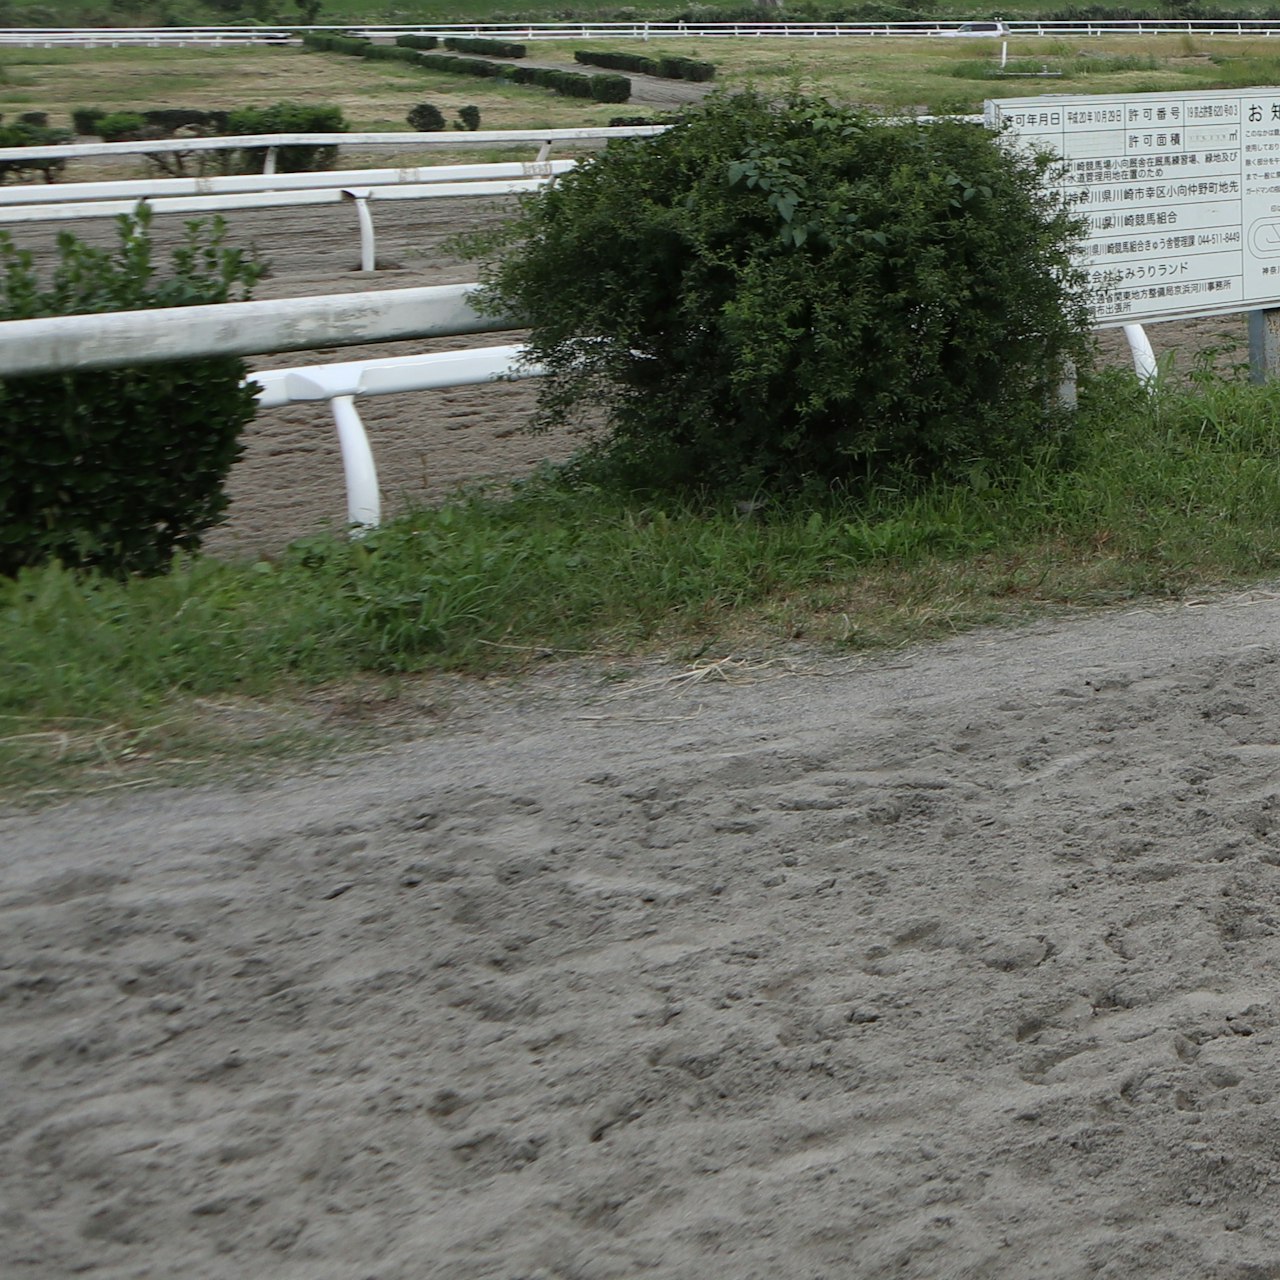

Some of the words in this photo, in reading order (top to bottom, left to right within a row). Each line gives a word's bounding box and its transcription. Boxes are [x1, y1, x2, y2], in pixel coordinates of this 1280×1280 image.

[1067, 109, 1121, 124] 平成20年10月29日
[1128, 106, 1180, 121] 許可番号
[1128, 132, 1181, 148] 許可面積
